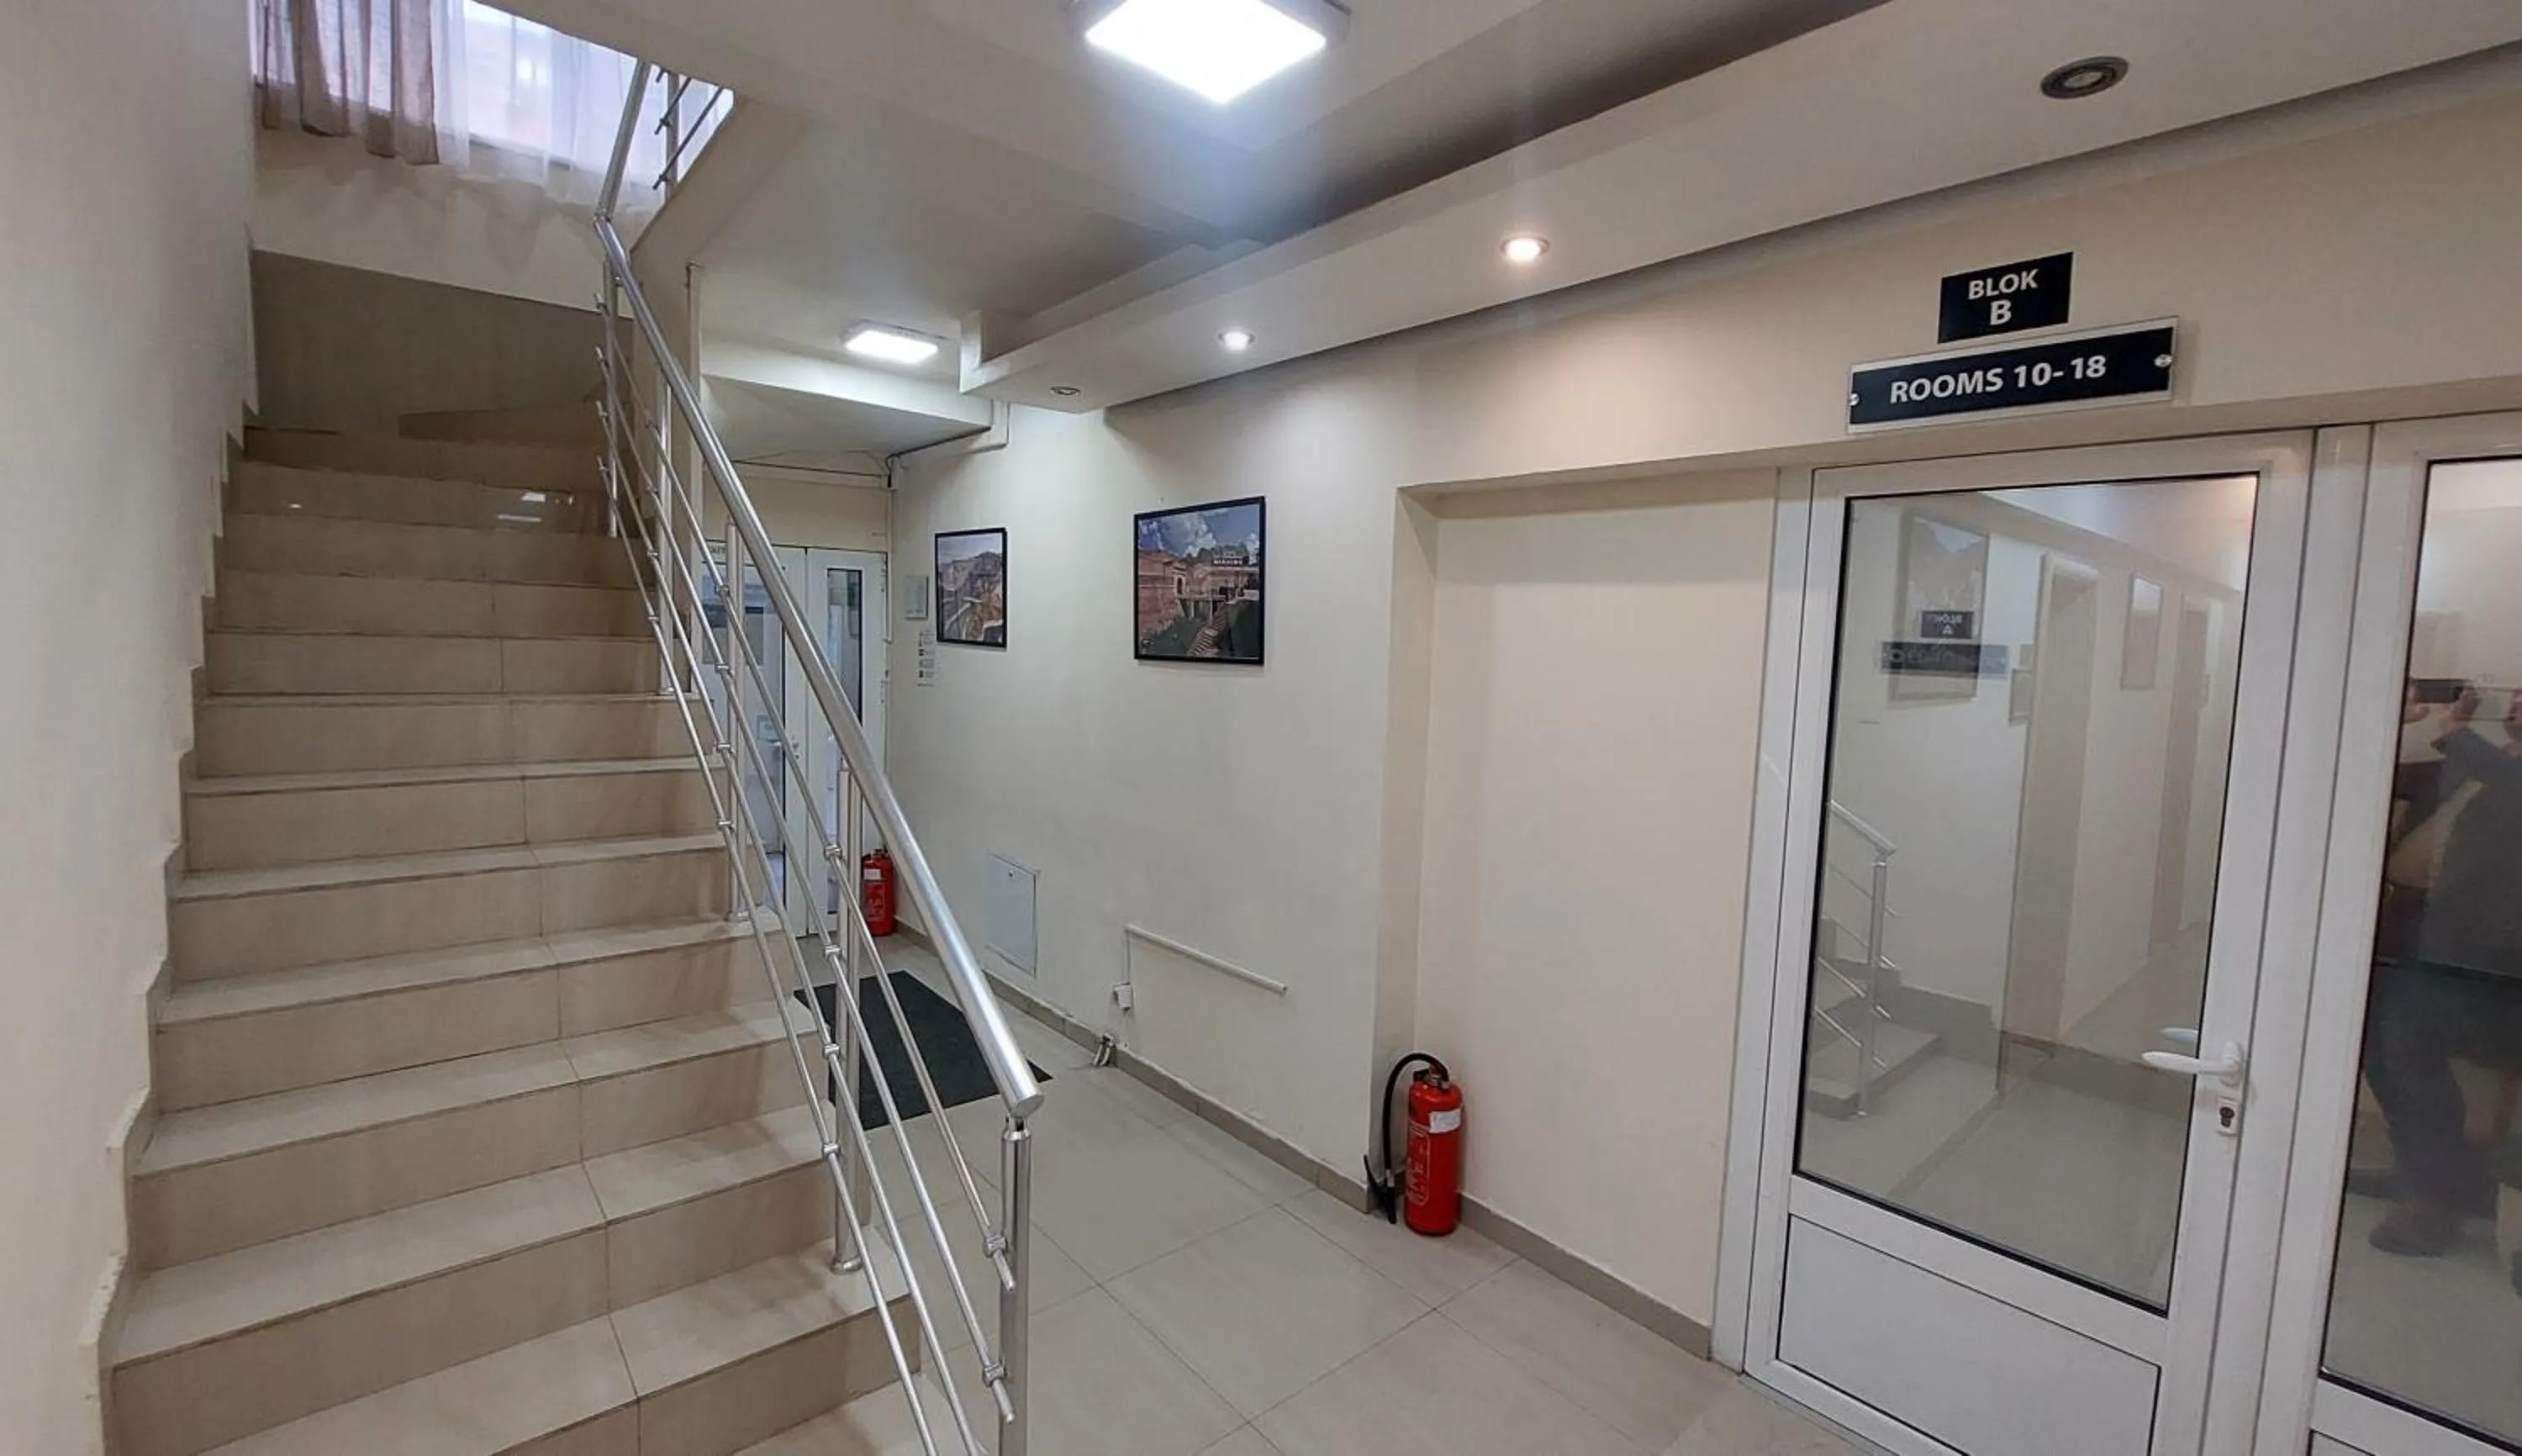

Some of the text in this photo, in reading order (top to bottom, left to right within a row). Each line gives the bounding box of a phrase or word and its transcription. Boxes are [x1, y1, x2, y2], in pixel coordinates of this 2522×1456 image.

[1968, 268, 2039, 300] BLOK
[1990, 299, 2012, 325] B
[1890, 367, 2004, 404] ROOMS
